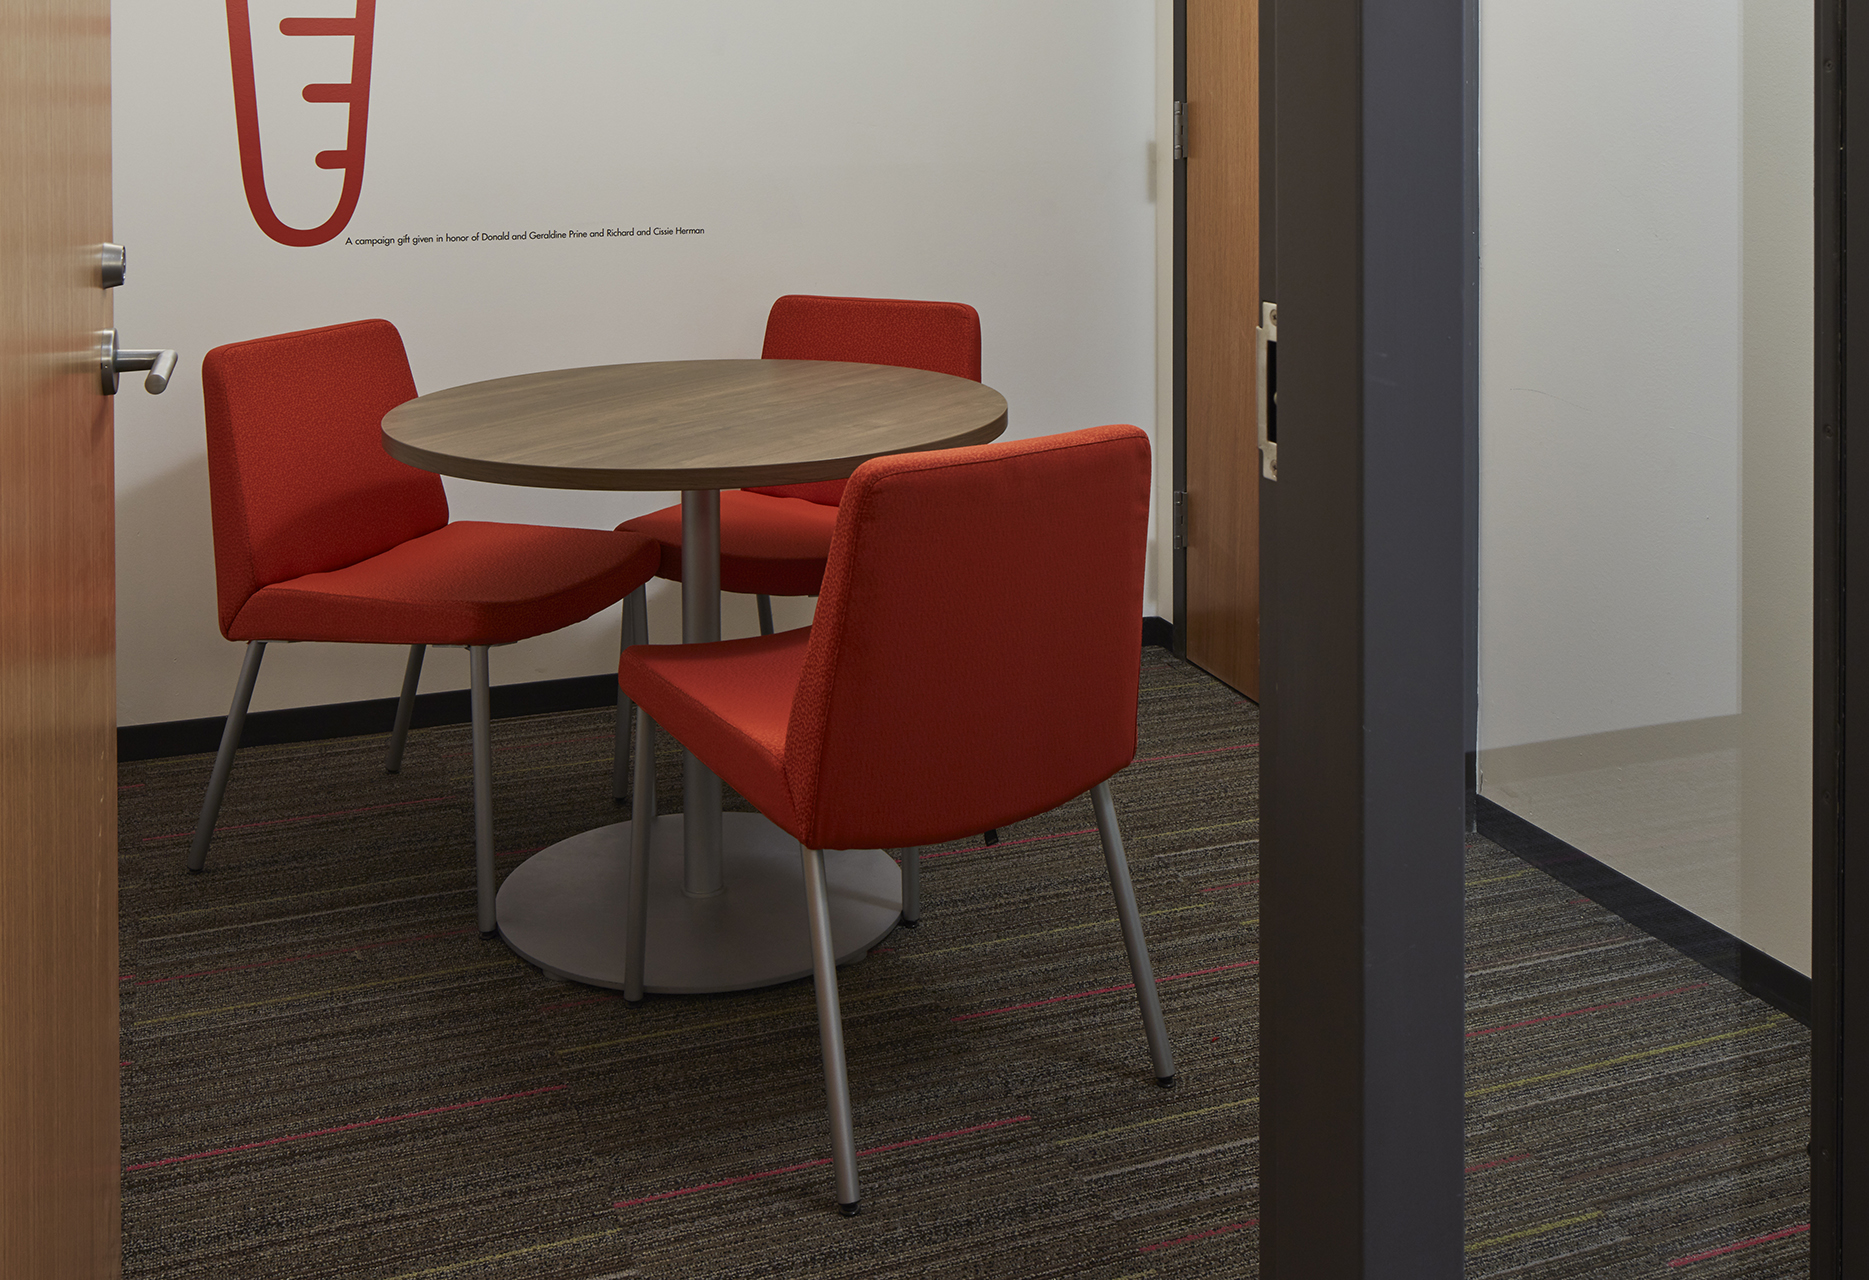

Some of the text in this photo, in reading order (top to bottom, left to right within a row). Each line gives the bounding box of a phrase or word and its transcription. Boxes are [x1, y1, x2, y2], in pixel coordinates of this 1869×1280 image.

[344, 226, 705, 247] A campaign gift given in honor of Donald and Geraldine Prine and Richard and Cissie Herman
